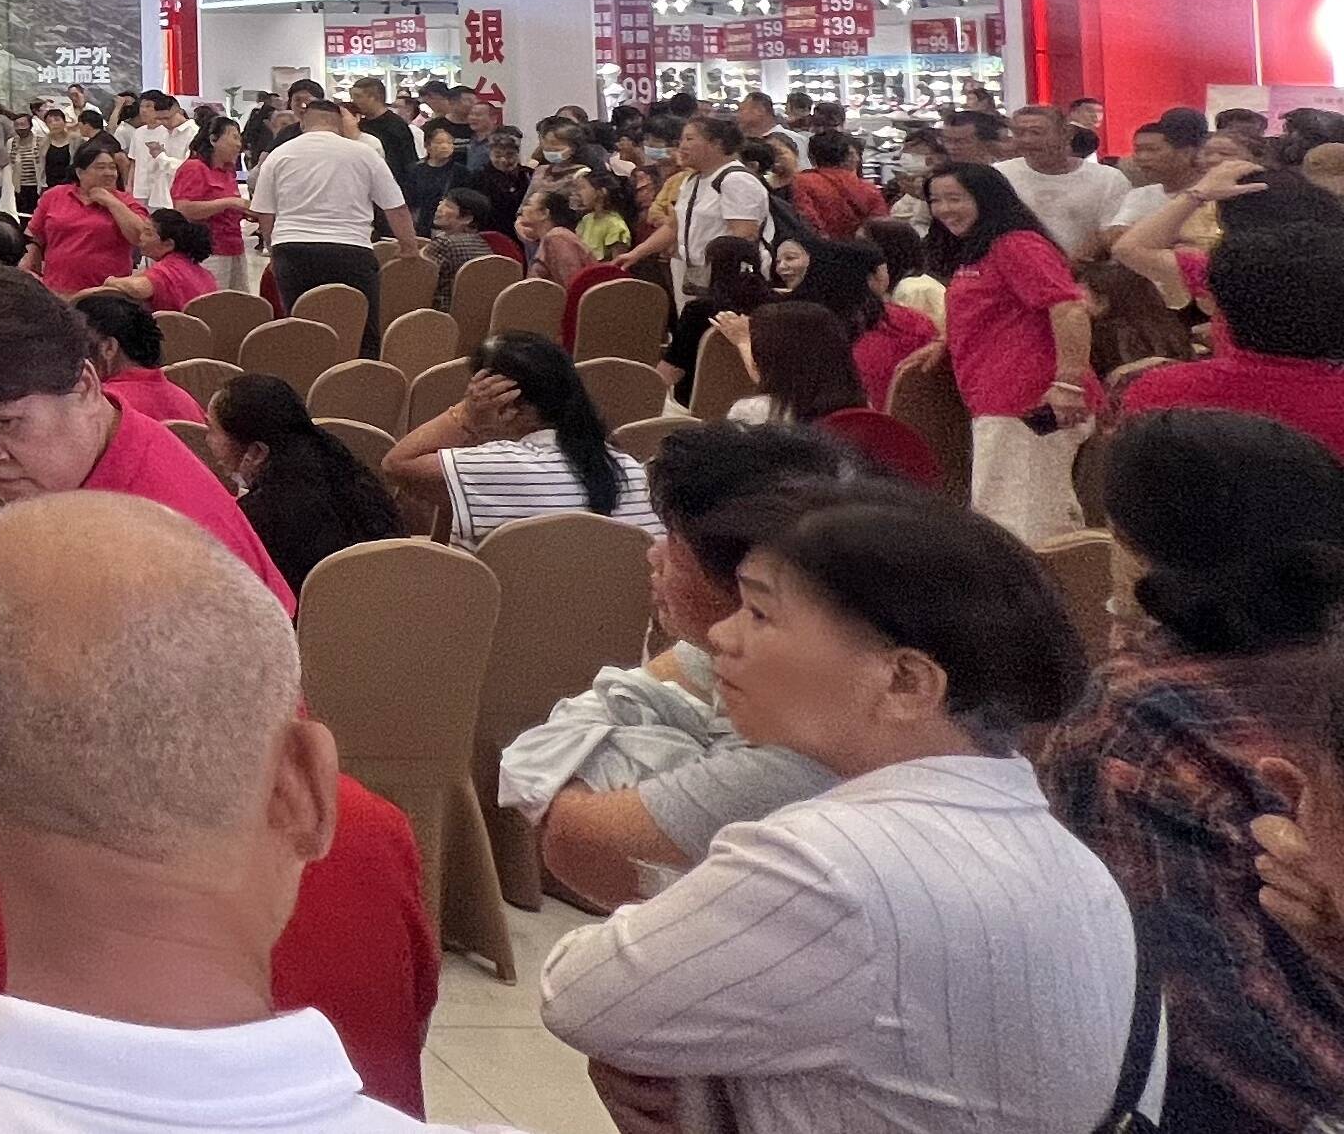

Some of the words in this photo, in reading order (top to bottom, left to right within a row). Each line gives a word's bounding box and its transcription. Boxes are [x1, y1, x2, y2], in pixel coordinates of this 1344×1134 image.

[763, 20, 783, 37] 59
[831, 16, 856, 35] 39
[350, 35, 374, 55] 99
[764, 40, 785, 57] 39
[55, 46, 112, 65] 为户外
[38, 65, 111, 84] 冲锋而生
[622, 76, 652, 105] 99
